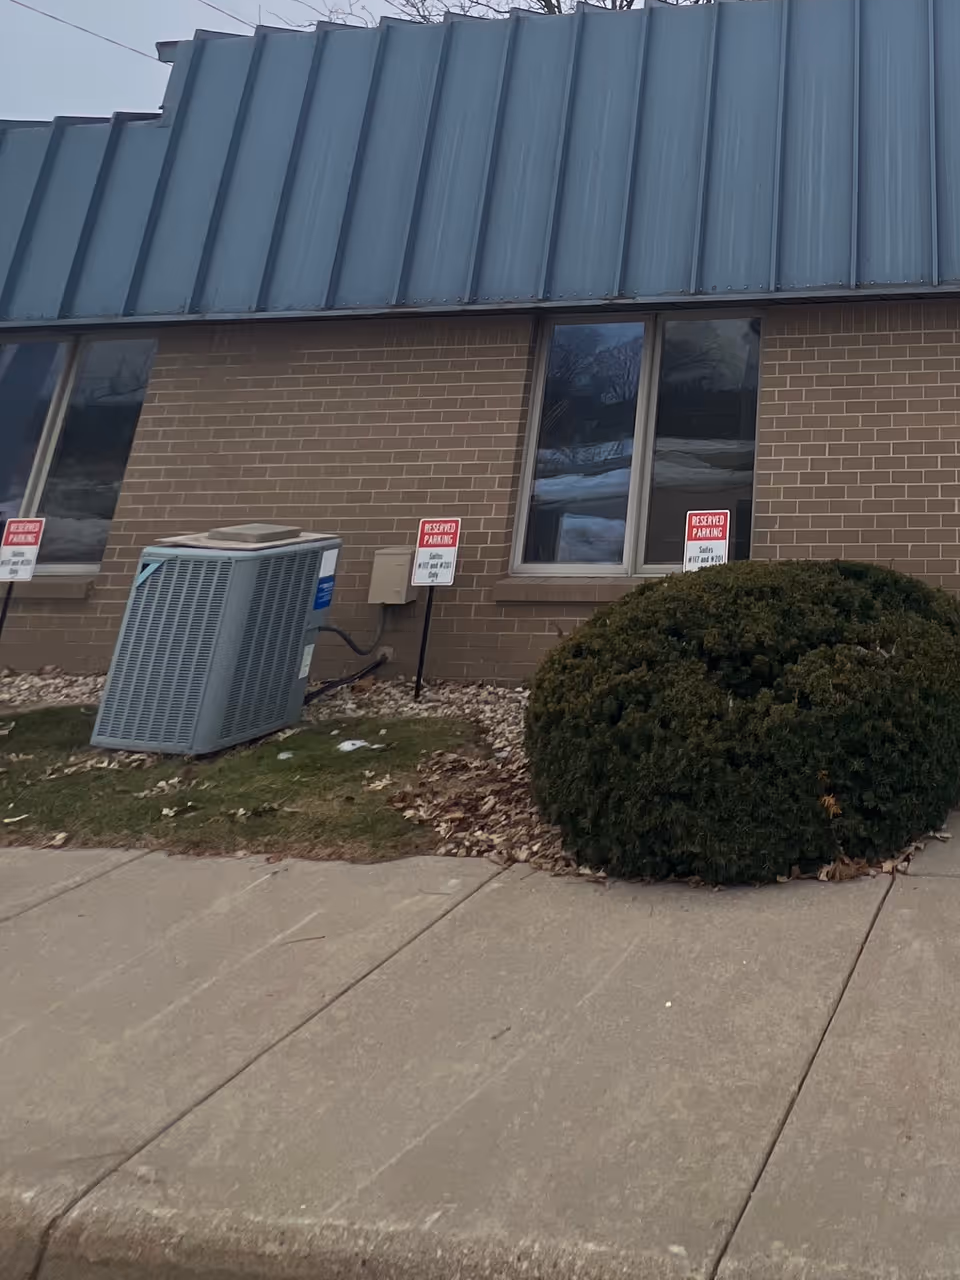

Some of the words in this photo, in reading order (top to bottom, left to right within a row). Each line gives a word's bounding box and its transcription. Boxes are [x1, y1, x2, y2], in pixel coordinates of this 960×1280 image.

[691, 514, 725, 526] RESERVED
[423, 523, 456, 533] RESERVED
[692, 527, 723, 538] PARKING
[423, 534, 454, 545] PARKING
[698, 545, 714, 554] Suites
